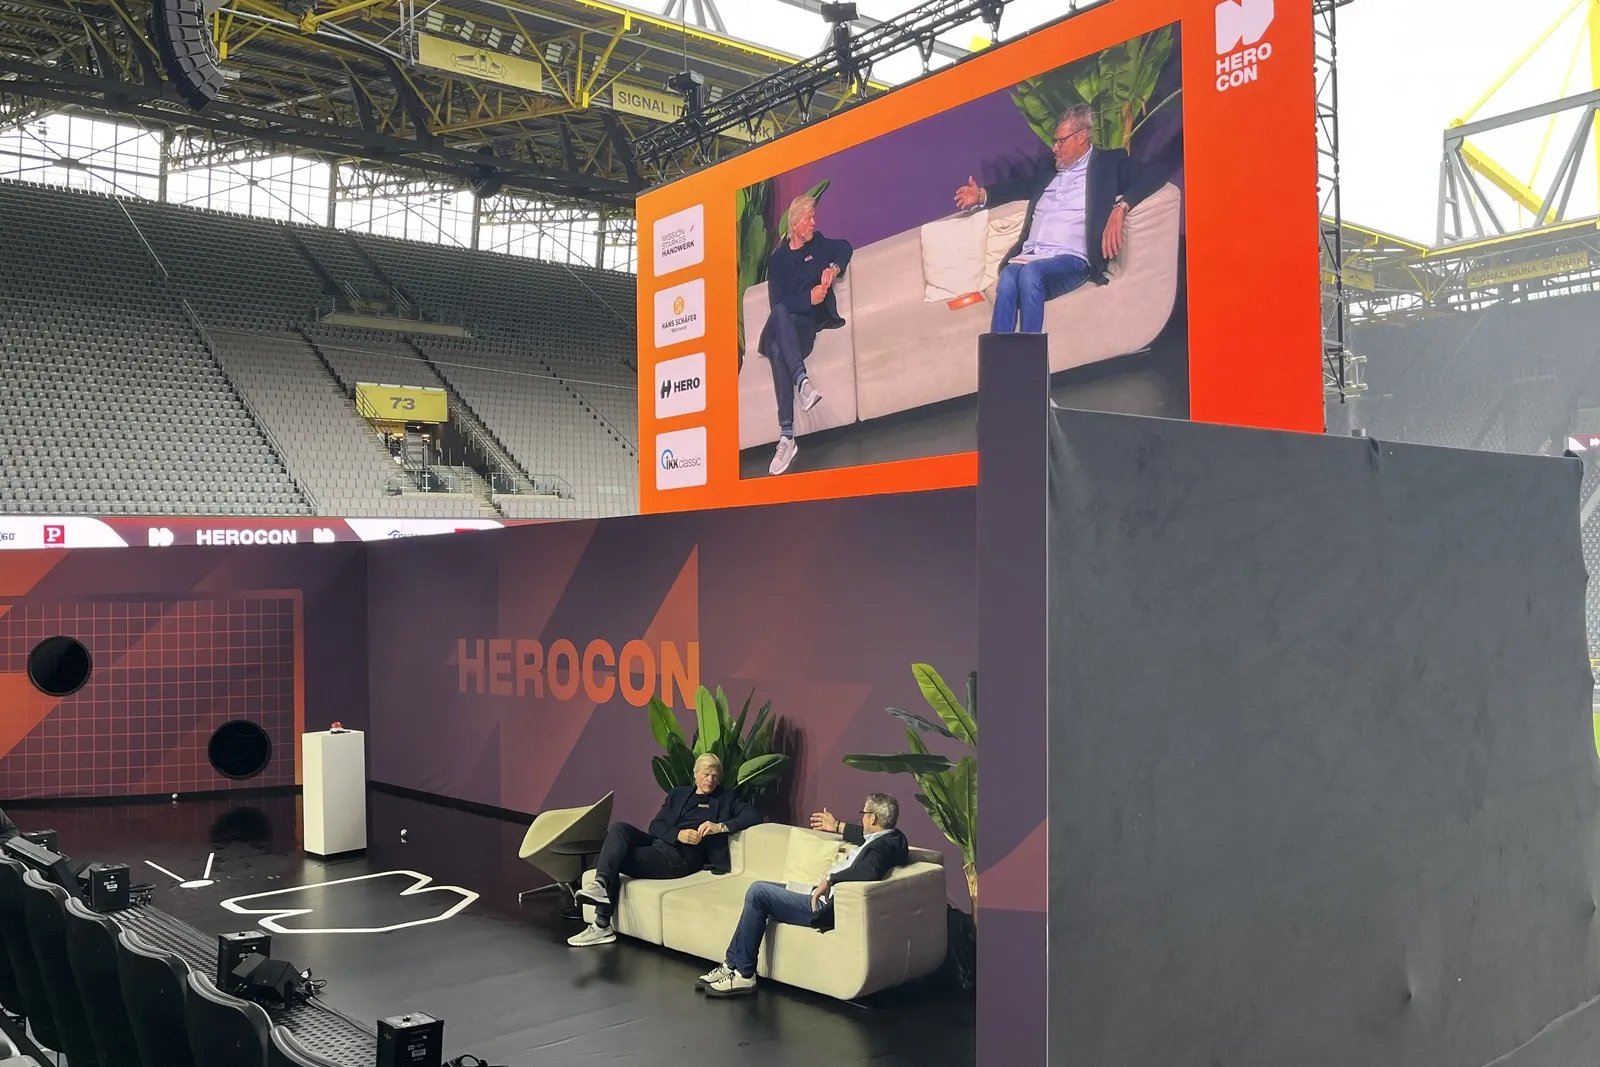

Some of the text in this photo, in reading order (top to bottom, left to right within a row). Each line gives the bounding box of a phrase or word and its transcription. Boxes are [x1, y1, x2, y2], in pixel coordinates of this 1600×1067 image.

[1216, 42, 1272, 76] HERO
[1216, 64, 1258, 92] CON
[618, 91, 669, 115] SIGNAL
[738, 120, 771, 139] PK
[661, 229, 685, 242] MISSION
[661, 235, 687, 251] STARKES
[661, 240, 695, 258] HANDWERK
[1471, 255, 1585, 284] SIGNAL IDUNA PARK
[661, 319, 675, 330] HANS
[675, 313, 697, 327] SCHÄFER
[673, 376, 701, 394] HERO
[389, 396, 416, 411] 73
[196, 528, 297, 546] HEROCON
[458, 637, 699, 710] HEROCON
